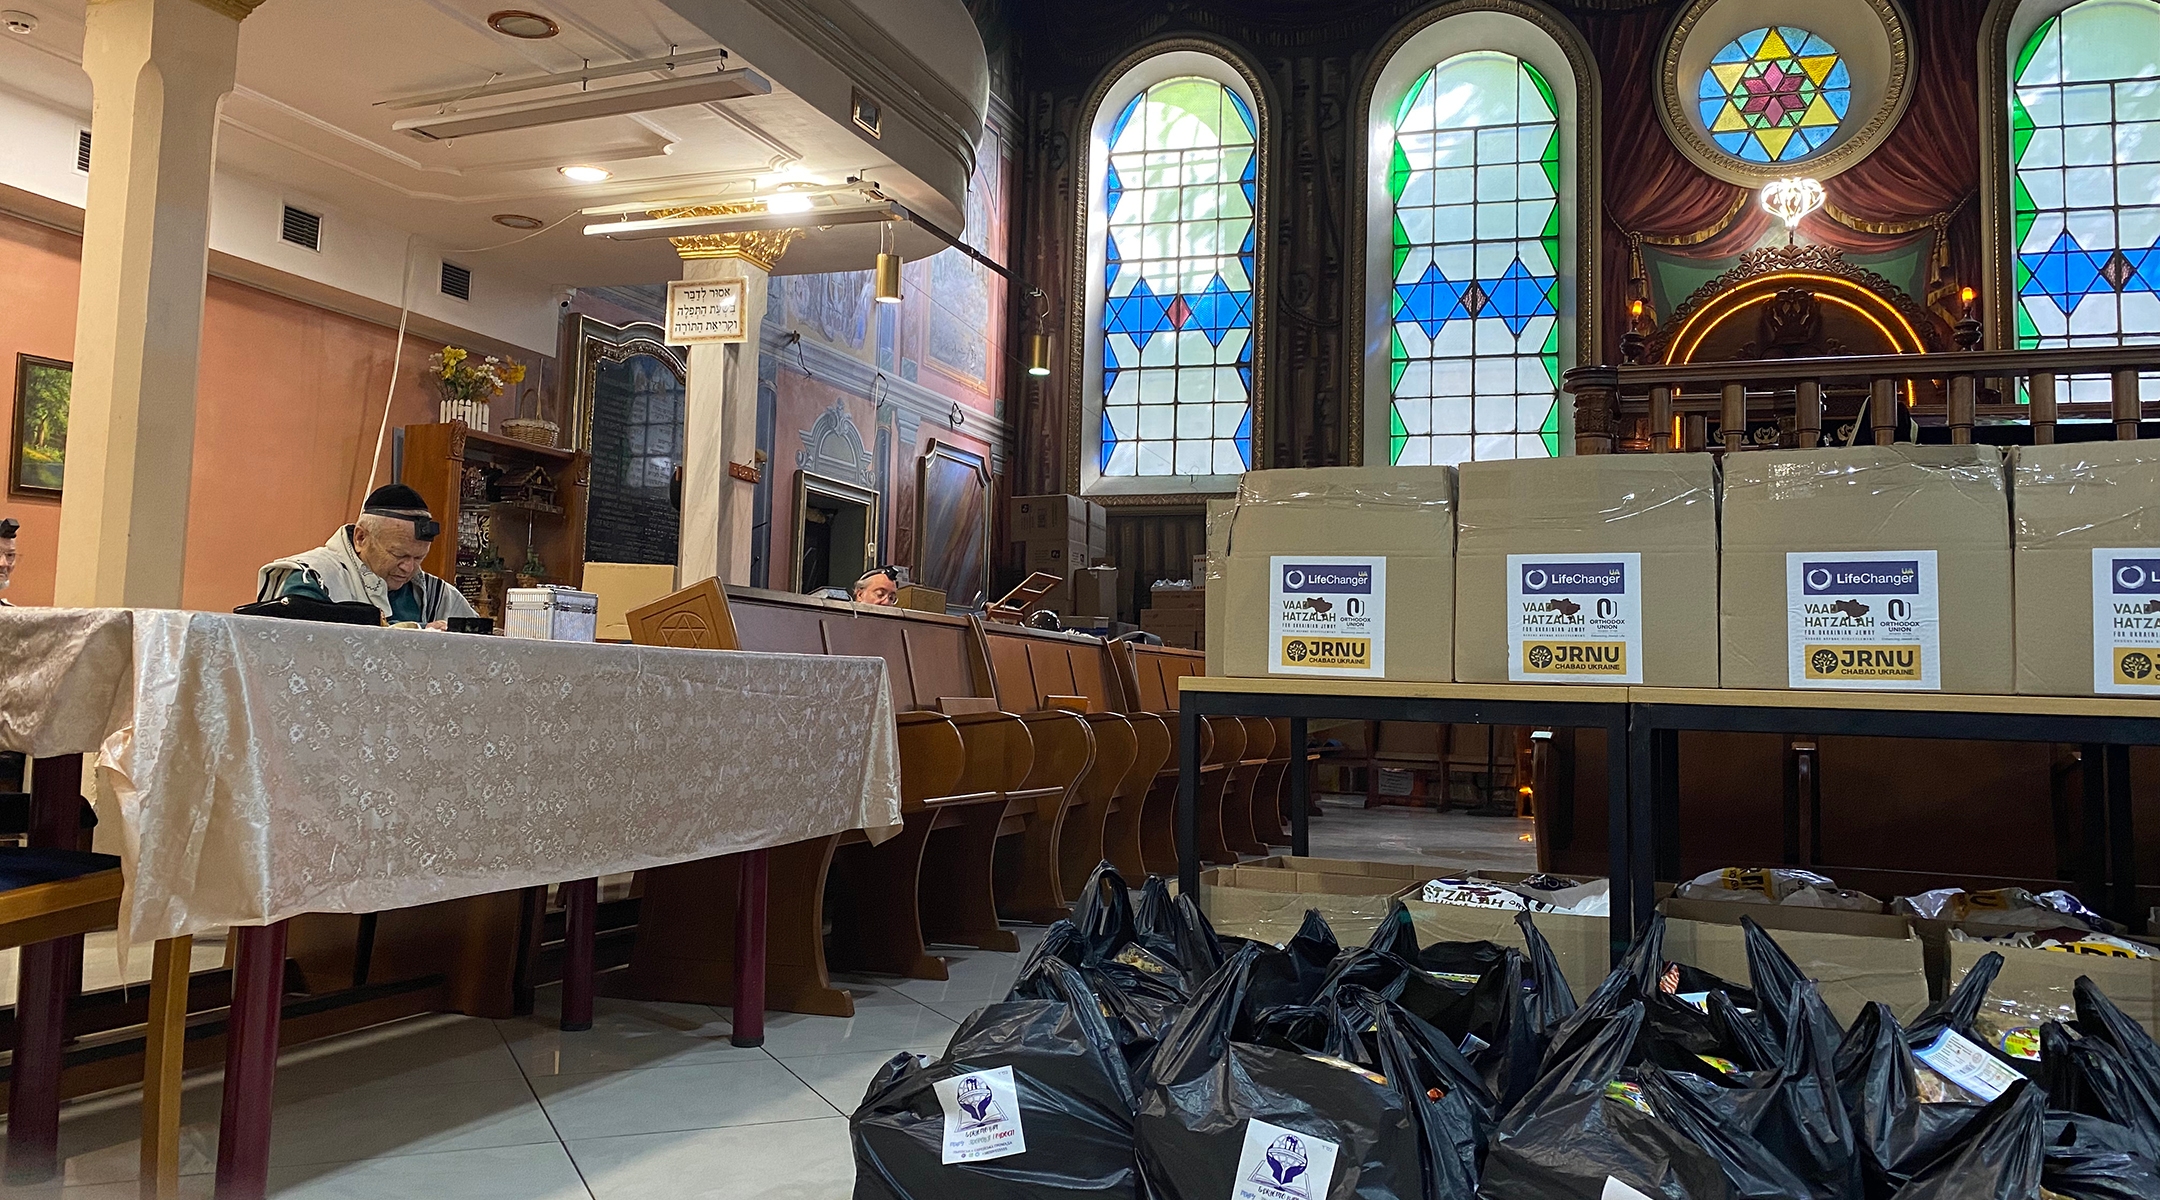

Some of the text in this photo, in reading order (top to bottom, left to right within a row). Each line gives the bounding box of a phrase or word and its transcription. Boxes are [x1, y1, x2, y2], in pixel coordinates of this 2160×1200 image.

[1308, 574, 1368, 586] LifeChanger
[1552, 574, 1620, 586] LifeChanger
[1836, 574, 1914, 585] LifeChanger
[1282, 612, 1336, 622] HATZALAH
[1523, 615, 1585, 625] HATZALAH
[1805, 617, 1874, 627] HATZALAH
[2114, 617, 2160, 628] HATZA
[1309, 641, 1365, 658] JRNU
[1555, 646, 1619, 663] JRNU
[1841, 650, 1913, 667] JRNU
